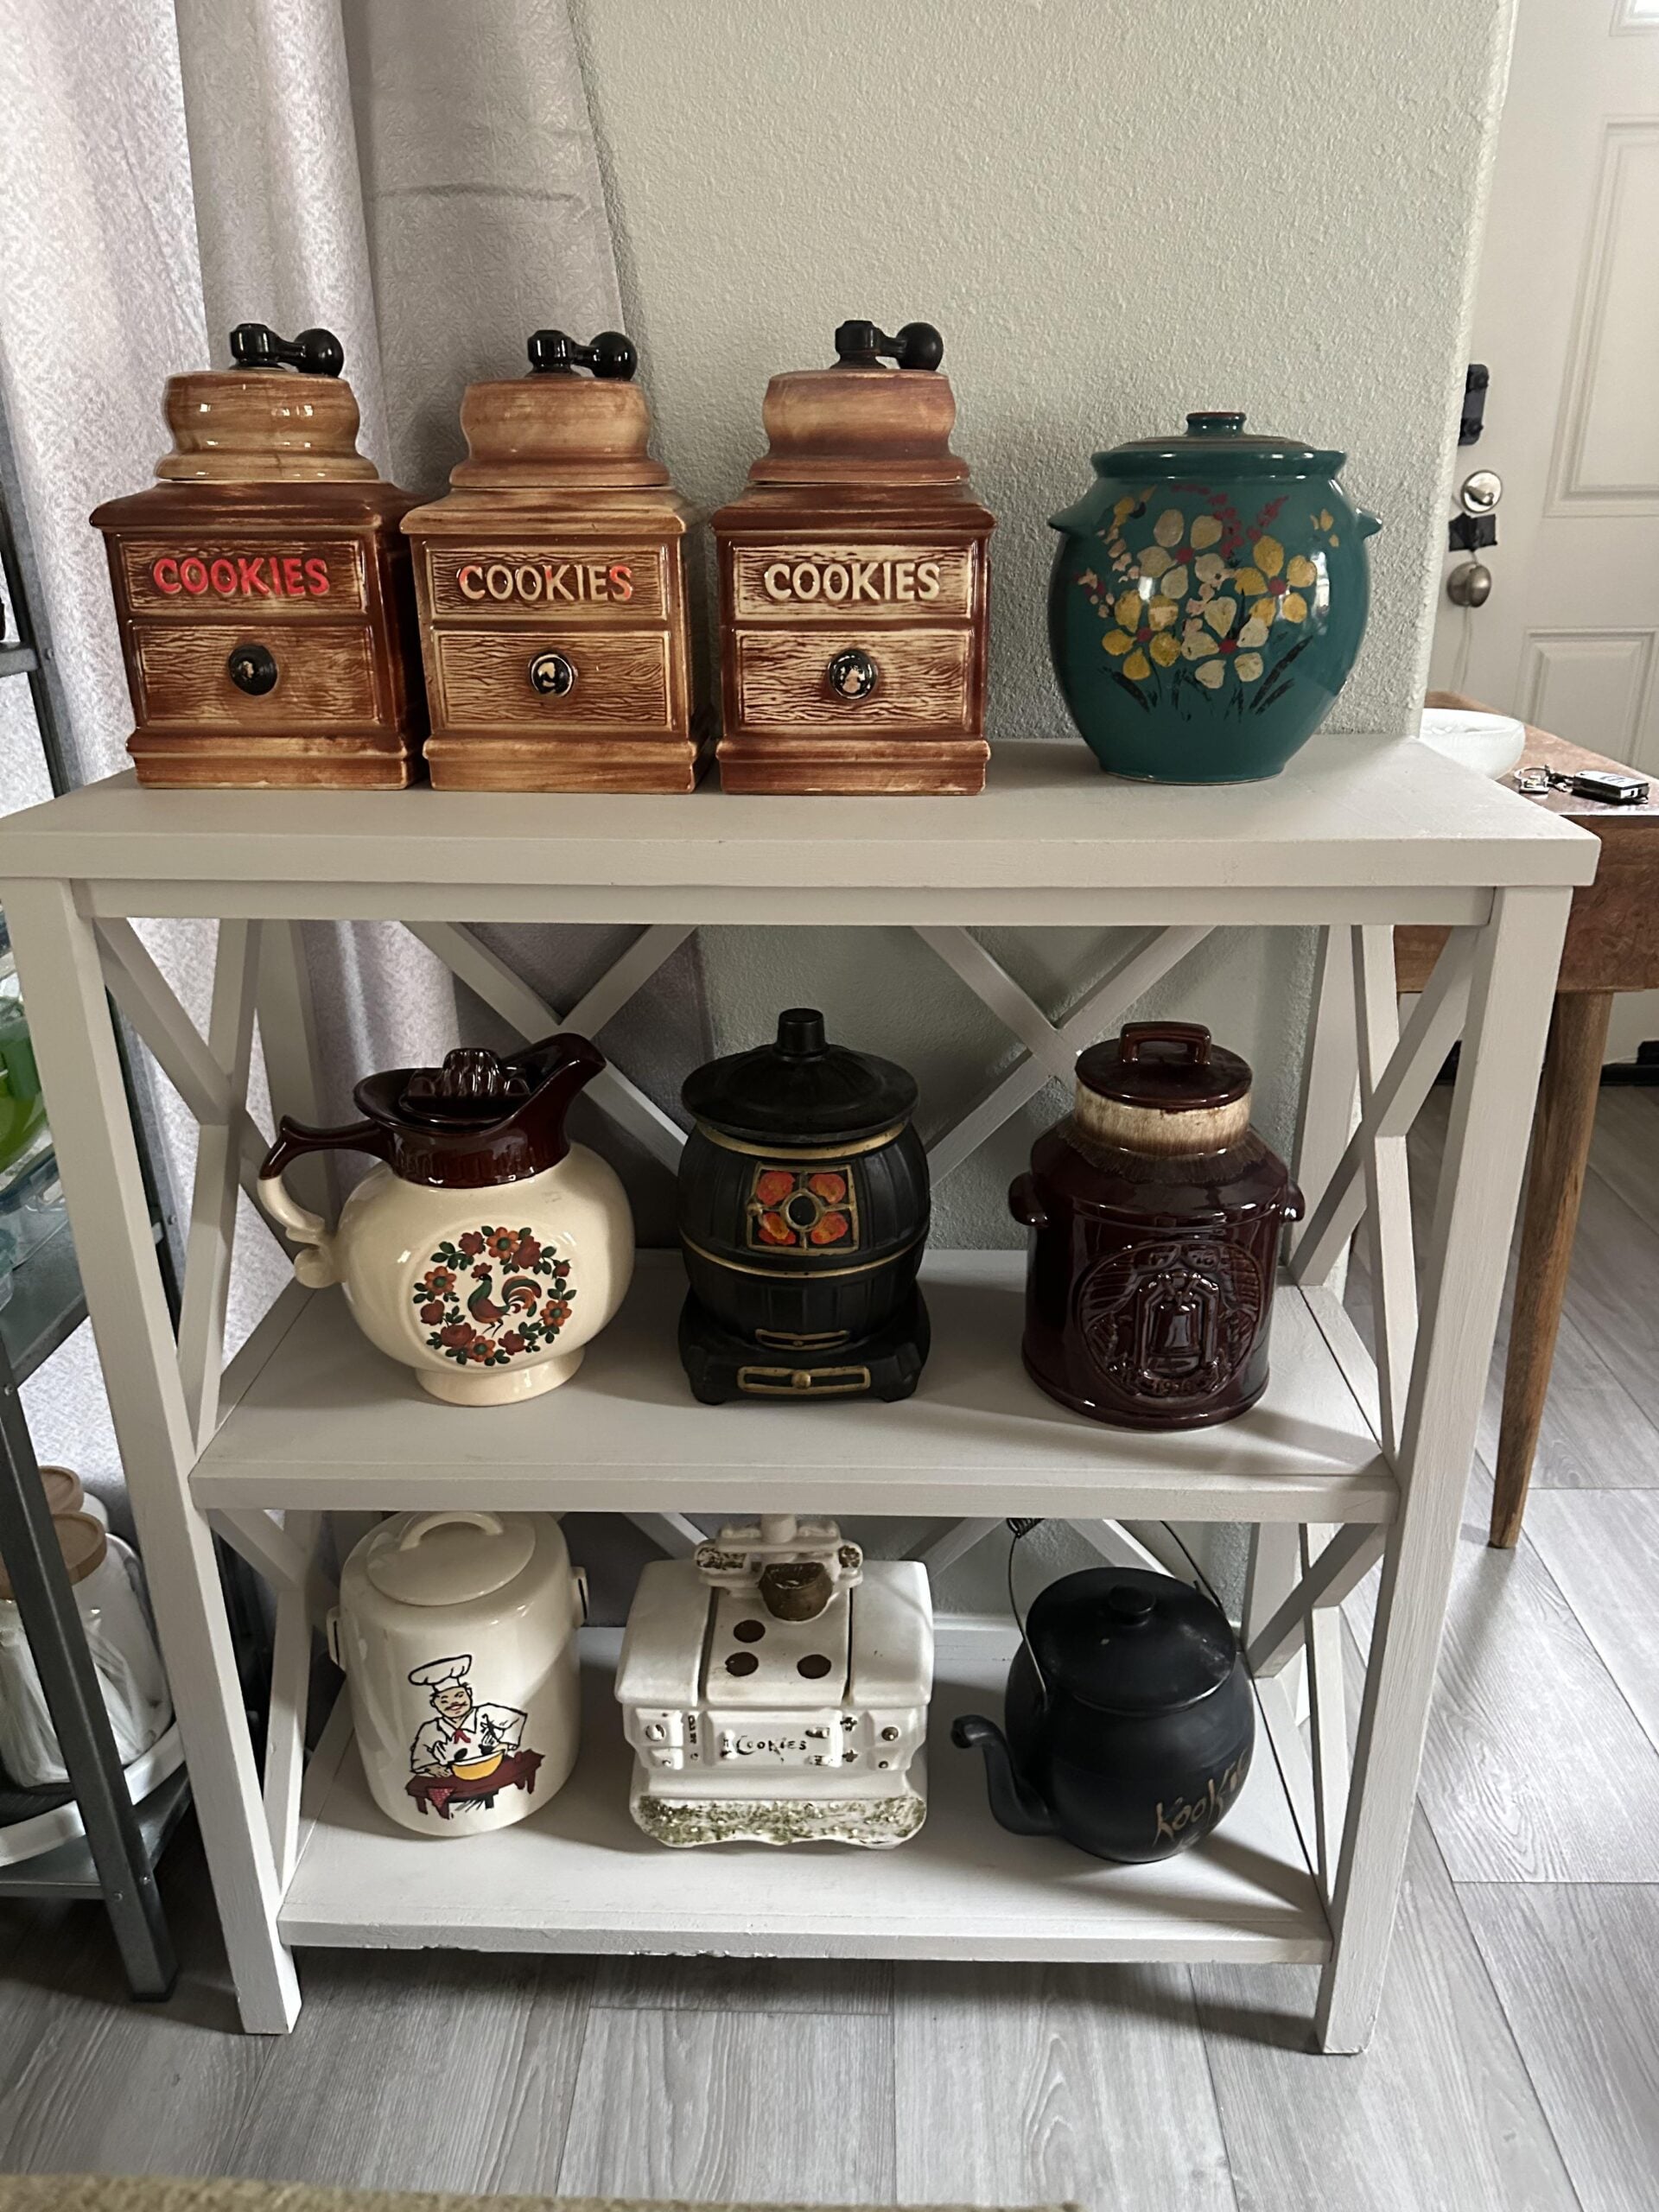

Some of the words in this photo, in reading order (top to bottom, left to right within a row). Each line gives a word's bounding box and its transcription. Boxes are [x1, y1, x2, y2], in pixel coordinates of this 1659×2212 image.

[153, 557, 330, 596] COOKIES
[458, 564, 633, 601] COOKIES
[764, 562, 941, 601] COOKIES
